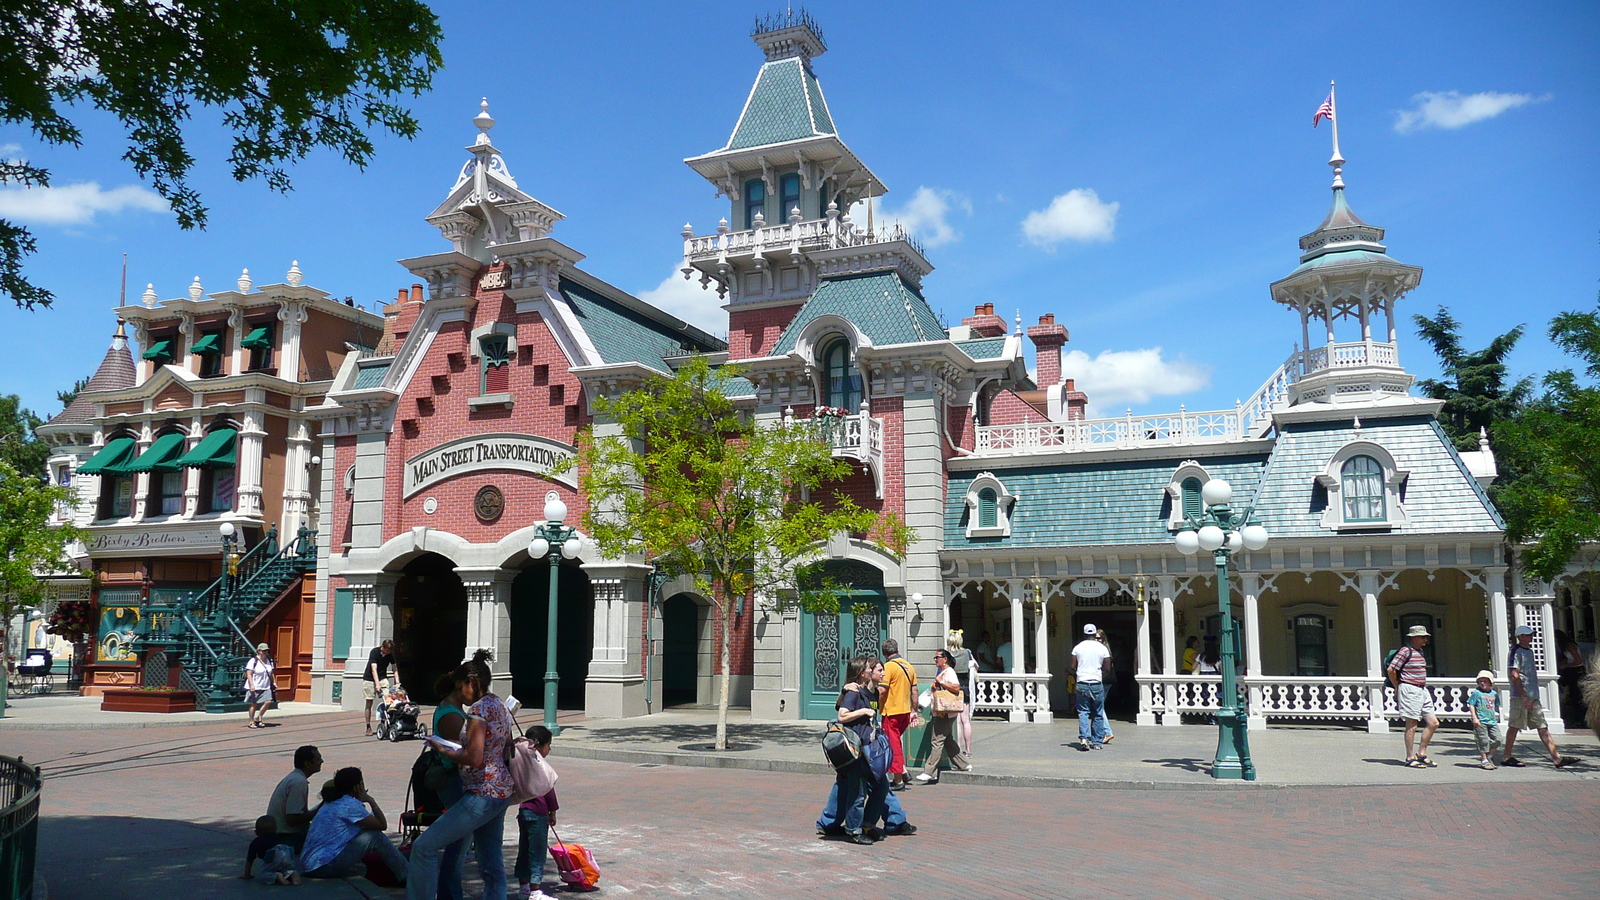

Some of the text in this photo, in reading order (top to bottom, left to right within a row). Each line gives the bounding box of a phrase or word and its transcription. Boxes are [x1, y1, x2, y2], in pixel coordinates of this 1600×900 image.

[412, 457, 439, 487] MAIN
[440, 446, 474, 473] STREET
[475, 442, 557, 468] TRANSPORTATION
[90, 532, 186, 549] Bixby Brothers
